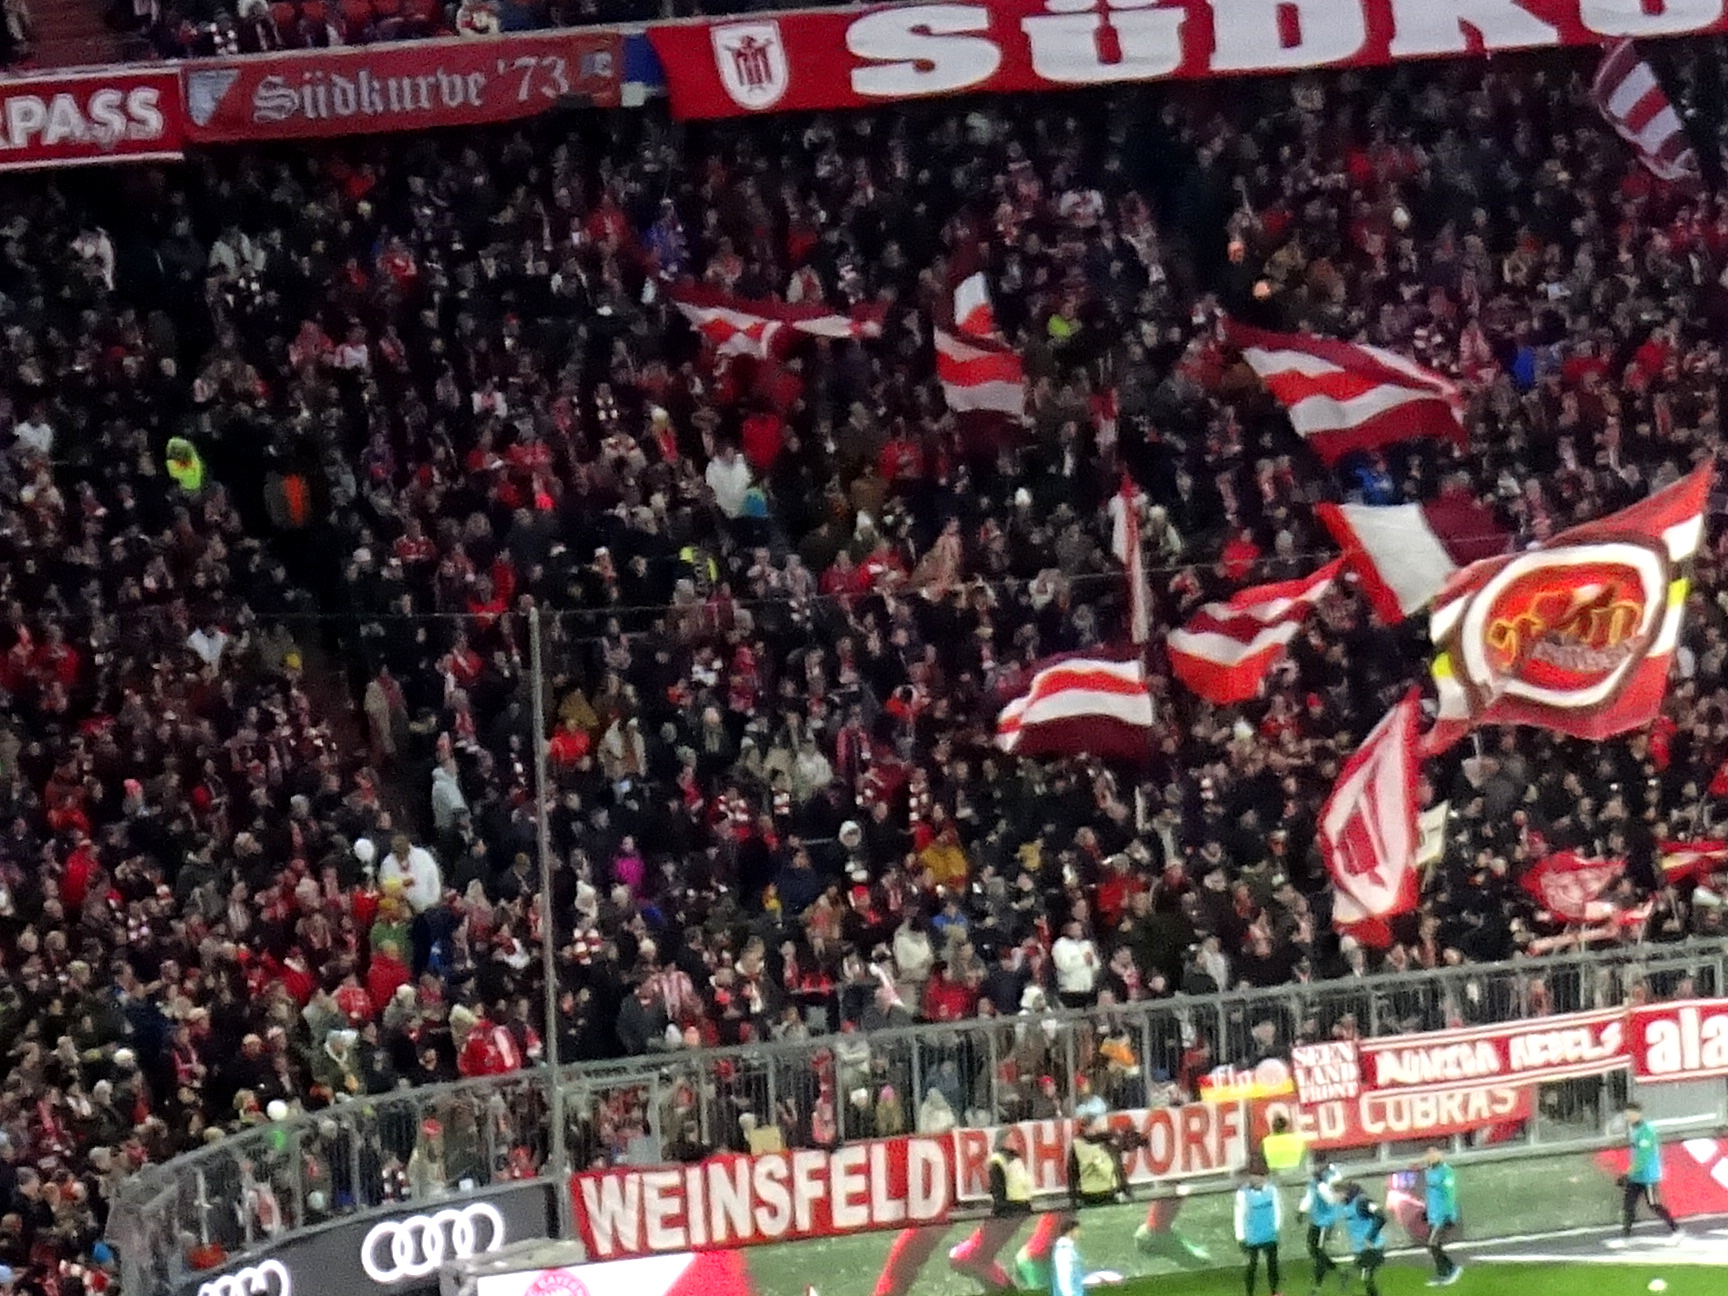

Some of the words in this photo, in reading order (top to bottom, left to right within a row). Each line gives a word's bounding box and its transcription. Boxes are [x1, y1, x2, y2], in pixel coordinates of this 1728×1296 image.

[0, 86, 165, 150] PASS
[252, 64, 487, 125] Südkurve
[959, 1101, 1242, 1194] ROHDORF
[580, 1138, 949, 1256] WEINSFELD
